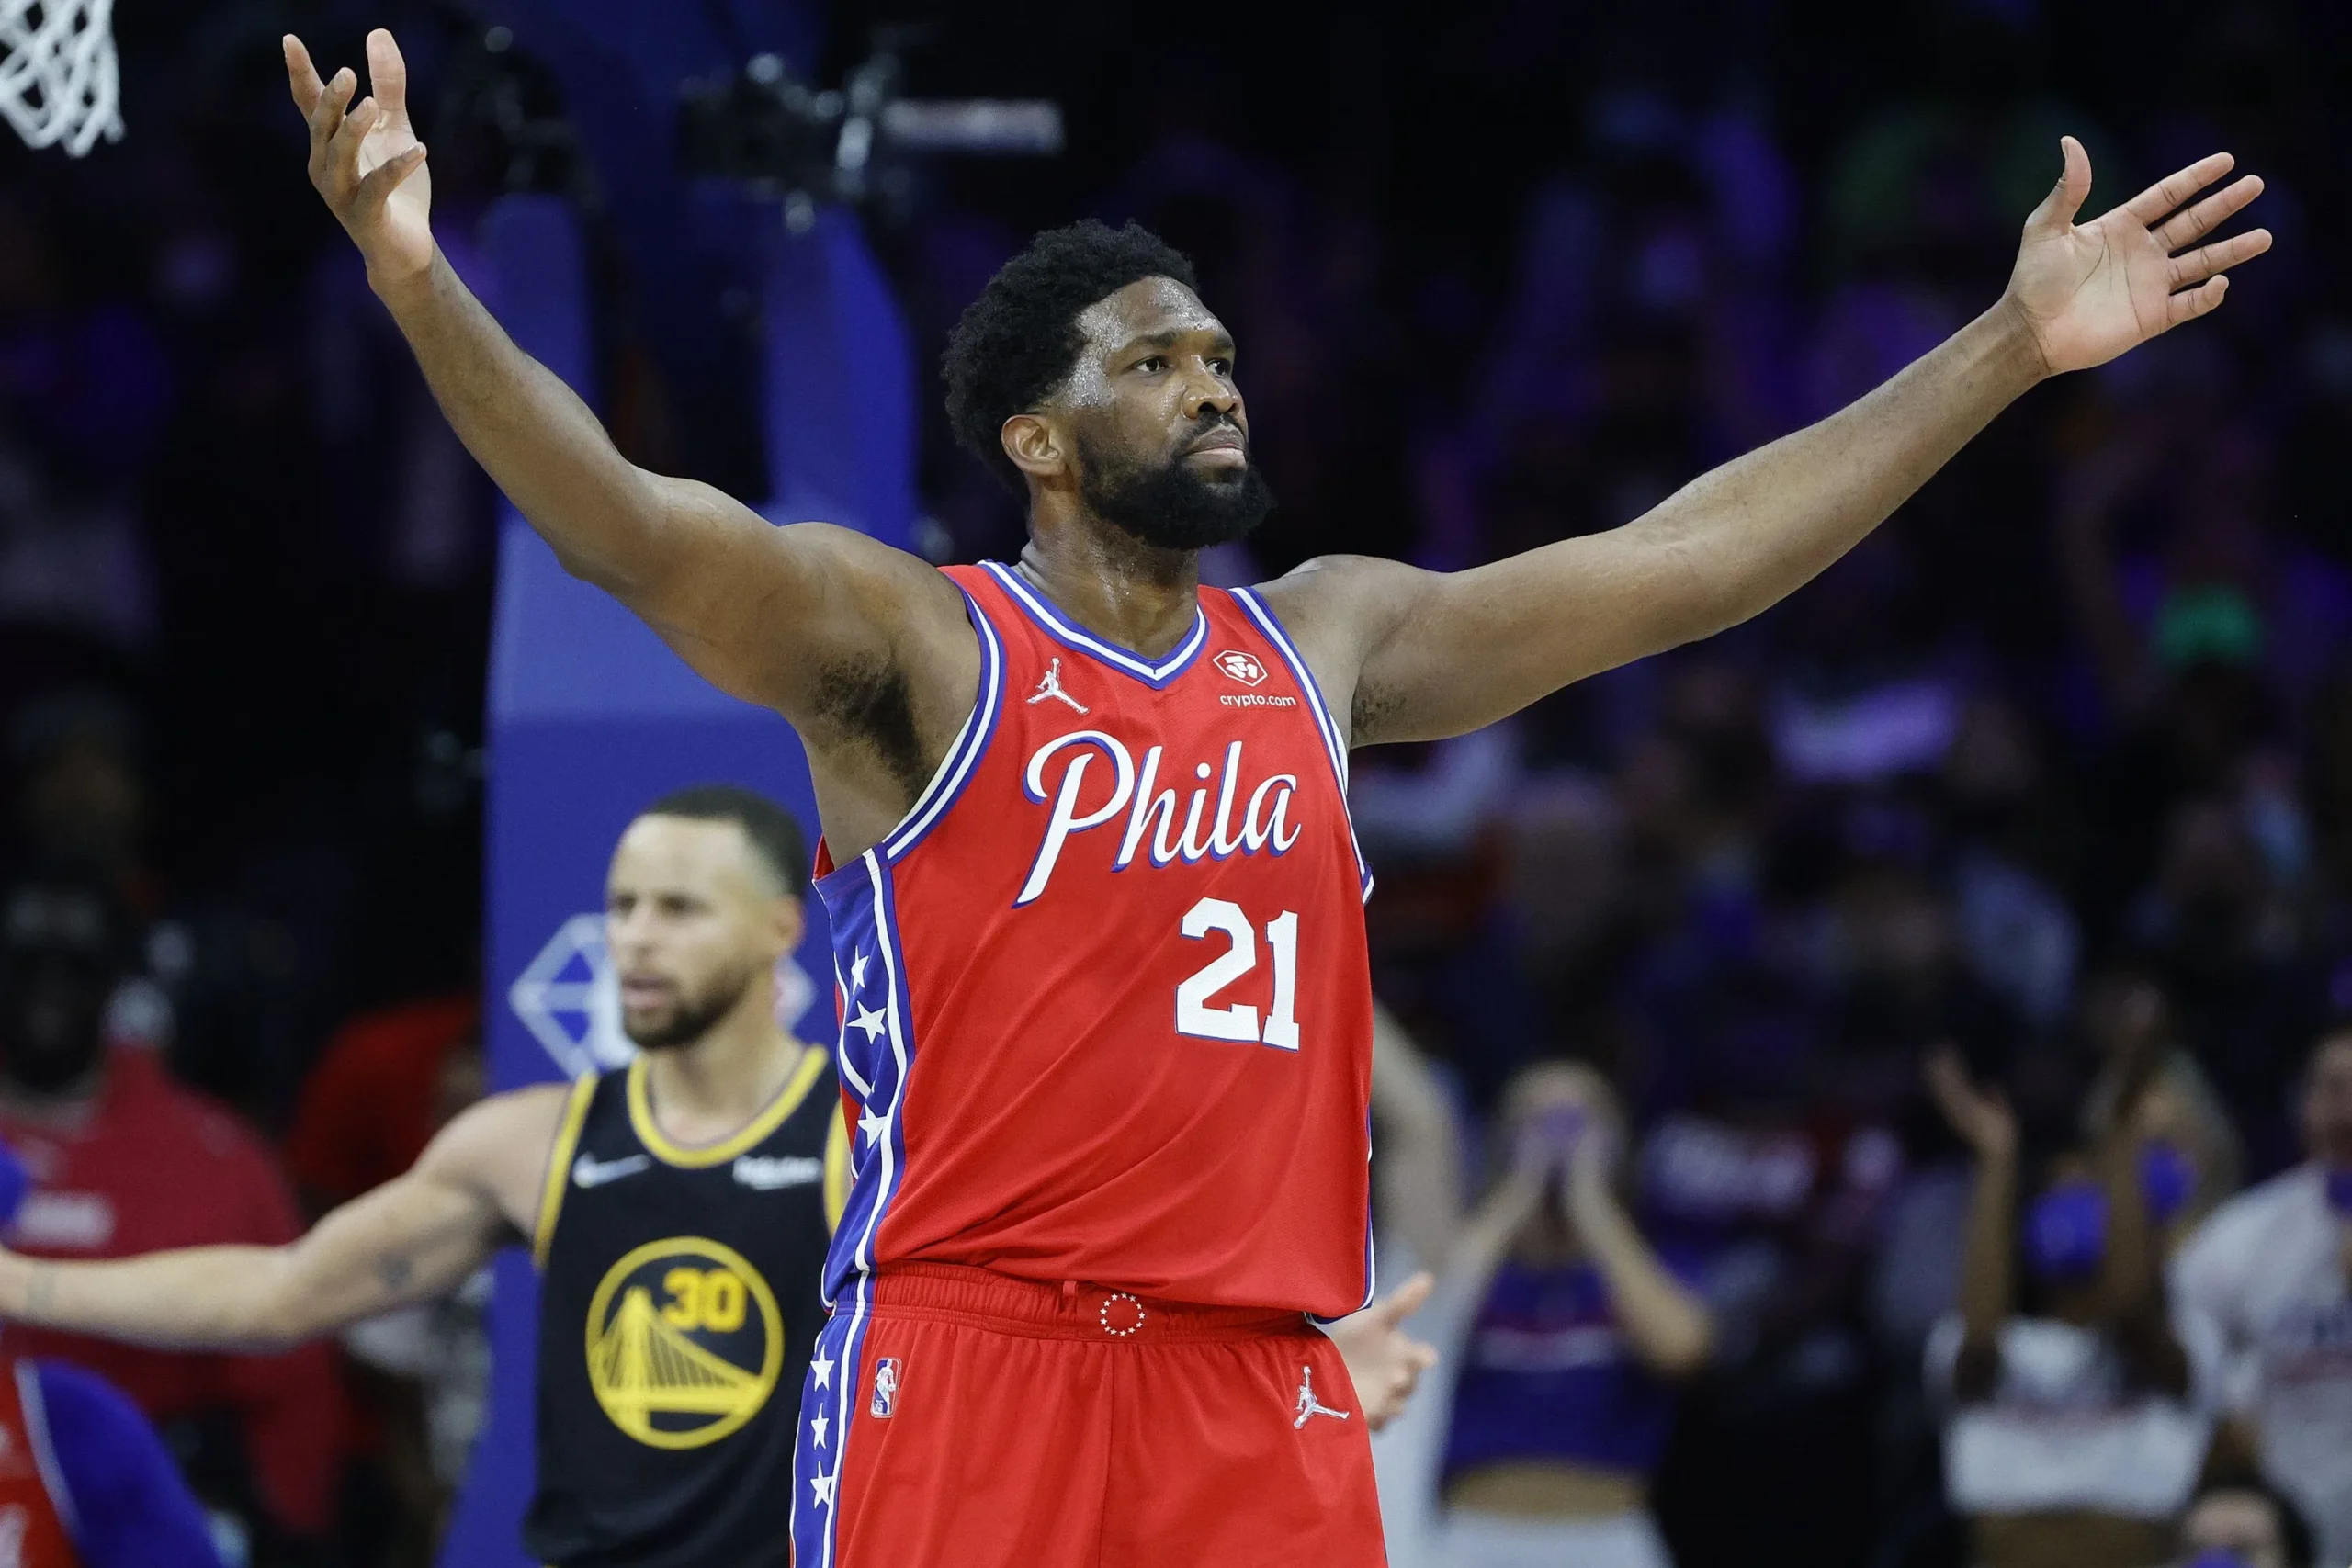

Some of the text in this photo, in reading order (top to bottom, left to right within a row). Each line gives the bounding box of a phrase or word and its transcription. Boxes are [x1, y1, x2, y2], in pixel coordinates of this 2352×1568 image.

[1219, 694, 1296, 708] crypto.com
[1011, 730, 1301, 908] Phila
[1175, 897, 1299, 1052] 21
[663, 1268, 747, 1332] 30
